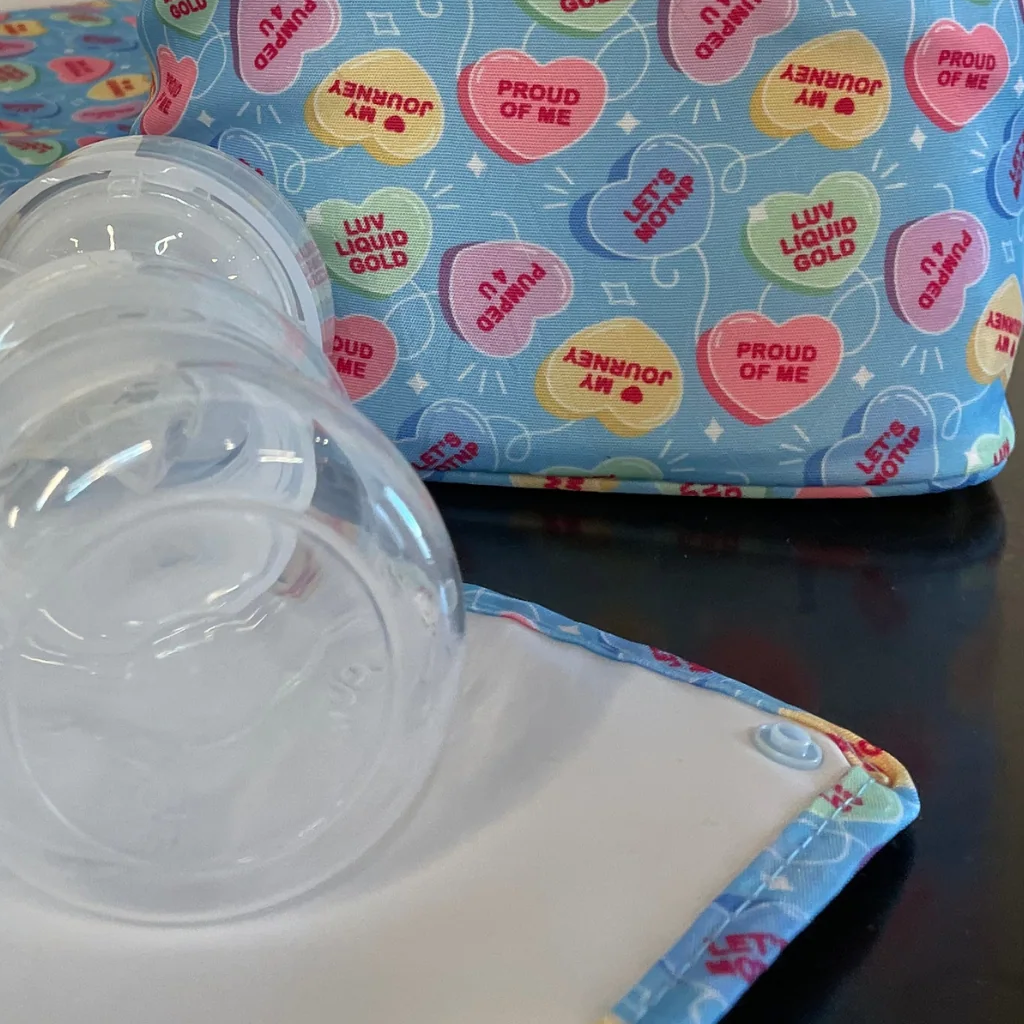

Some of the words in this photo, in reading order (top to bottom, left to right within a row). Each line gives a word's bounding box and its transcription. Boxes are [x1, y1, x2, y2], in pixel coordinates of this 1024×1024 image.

[938, 50, 996, 71] PROUD
[779, 64, 883, 96] JOURNEY
[937, 71, 962, 87] OF
[965, 74, 990, 90] ME
[328, 79, 434, 118] JOURNEY
[497, 80, 582, 106] PROUD
[794, 88, 828, 108] MY
[344, 102, 377, 123] MY
[500, 102, 531, 121] OF
[538, 105, 573, 127] ME
[343, 212, 385, 235] LUV
[791, 200, 836, 230] LUV
[334, 230, 409, 257] LIQUID
[780, 216, 858, 256] LIQUID
[349, 251, 409, 274] GOLD
[793, 238, 857, 273] GOLD
[917, 229, 972, 311] PUMPED
[477, 262, 548, 333] PUMPED
[332, 335, 373, 360] OUD
[737, 342, 817, 362] PROUD
[336, 357, 367, 379] ME
[563, 347, 673, 386] JOURNEY
[740, 363, 771, 381] OF
[776, 365, 810, 384] ME
[579, 374, 614, 395] MY
